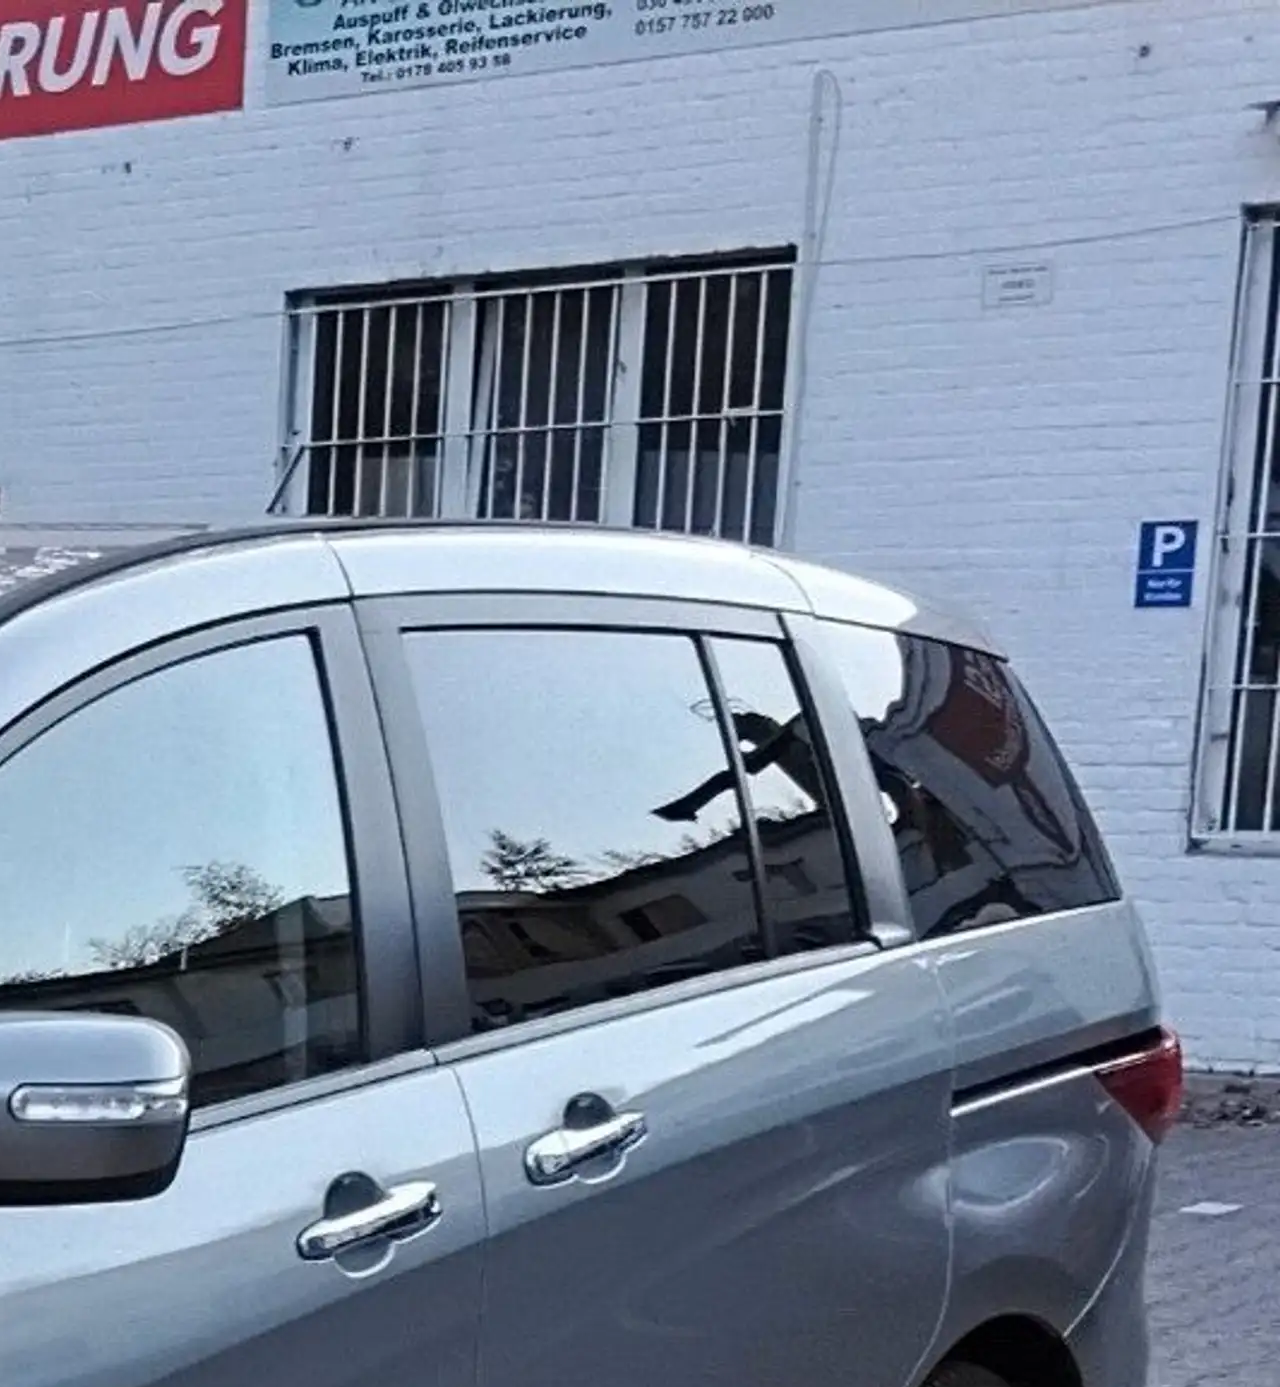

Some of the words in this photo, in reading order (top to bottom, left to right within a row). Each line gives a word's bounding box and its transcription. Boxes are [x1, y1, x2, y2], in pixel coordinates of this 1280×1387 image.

[270, 36, 360, 59] Bremsen,
[367, 18, 482, 46] Karosserie,
[489, 2, 613, 30] Lackierung,
[333, 5, 408, 30] Auspuff
[416, 2, 430, 20] &
[716, 9, 738, 26] 22
[288, 59, 348, 75] Klima,
[355, 44, 439, 67] Elektrik,
[445, 25, 587, 54] Reifenservice
[1152, 525, 1186, 567] P
